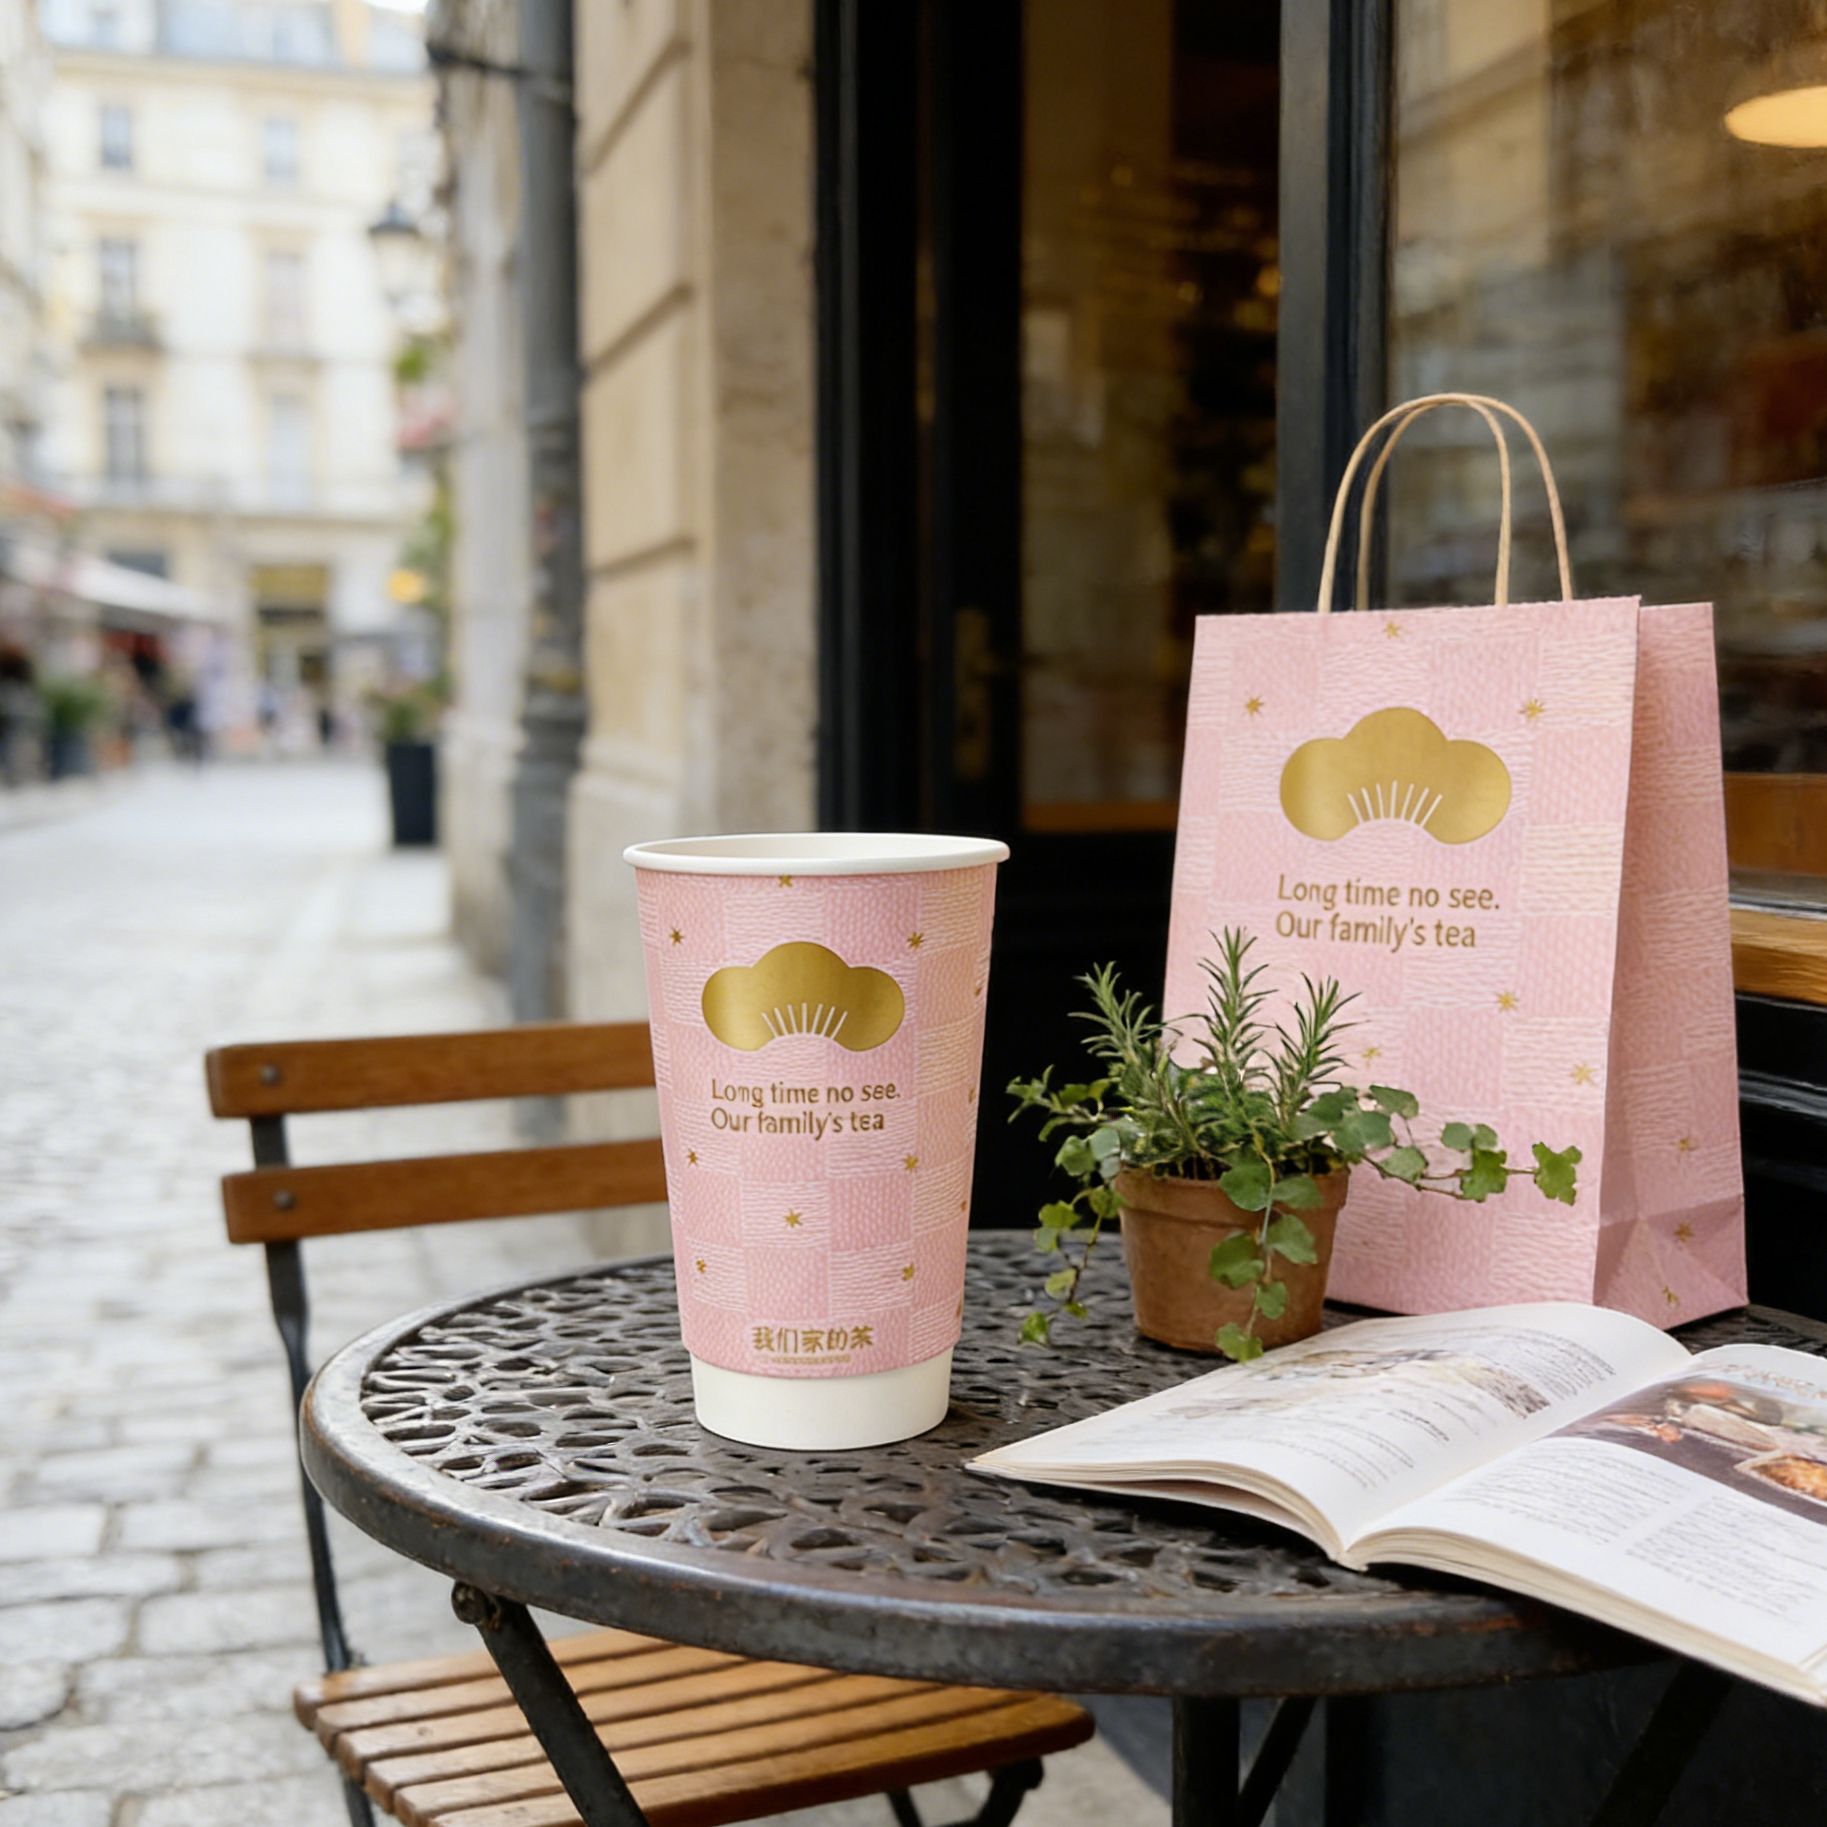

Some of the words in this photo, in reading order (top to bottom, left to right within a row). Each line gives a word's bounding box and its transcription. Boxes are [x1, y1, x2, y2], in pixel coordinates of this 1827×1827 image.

[1278, 874, 1338, 911] Long
[1345, 878, 1400, 906] time
[1409, 887, 1440, 908] no
[1449, 888, 1500, 910] see.
[1276, 911, 1323, 939] Our
[1330, 912, 1426, 953] family's
[1435, 919, 1476, 948] tea
[711, 1078, 764, 1108] Long
[770, 1081, 819, 1103] time
[826, 1086, 854, 1103] no
[861, 1082, 901, 1102] see.
[711, 1107, 751, 1132] Our
[758, 1111, 843, 1141] family's
[850, 1111, 884, 1132] tea
